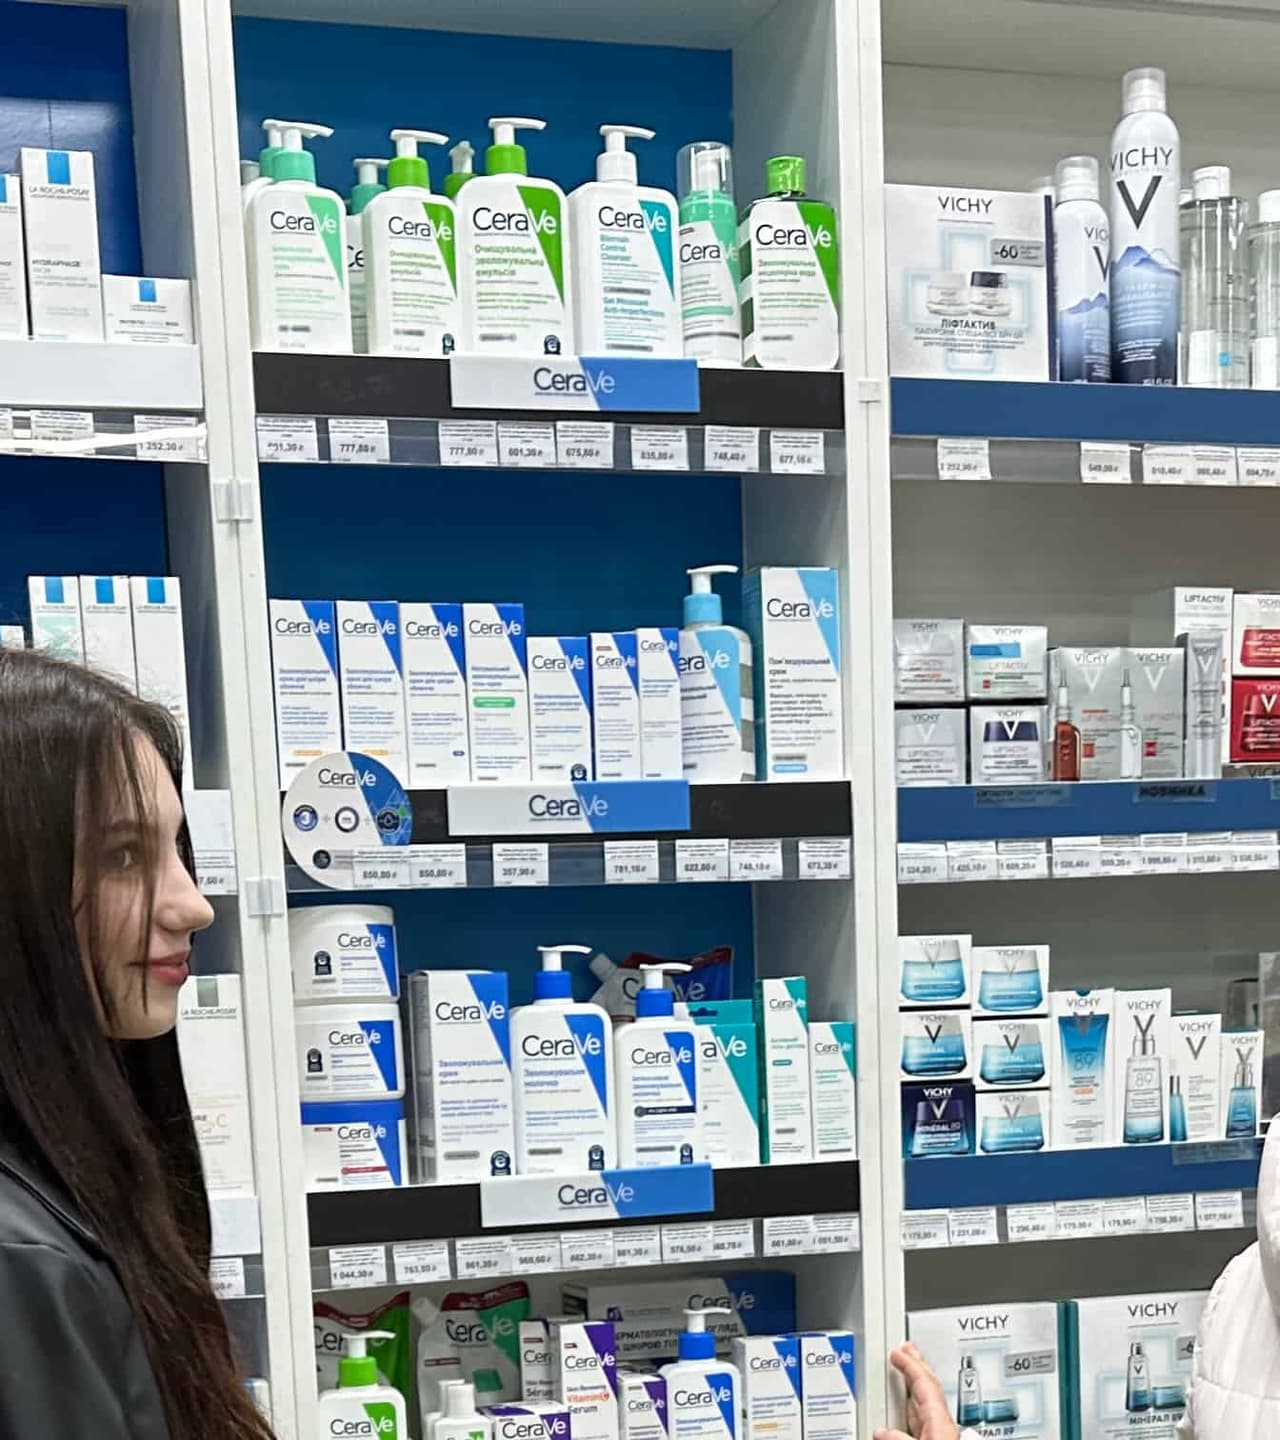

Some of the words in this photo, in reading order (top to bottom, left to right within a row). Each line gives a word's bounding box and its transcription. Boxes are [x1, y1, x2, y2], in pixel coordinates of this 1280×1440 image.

[1110, 147, 1174, 170] VICHY
[938, 197, 992, 213] VICHY
[270, 209, 337, 235] CeraVe
[472, 206, 558, 235] CeraVe
[598, 206, 666, 232] CeraVe
[388, 216, 452, 241] CeraVe
[756, 224, 832, 248] CeraVe
[994, 246, 1018, 260] -60
[534, 366, 615, 396] CeraVe
[767, 598, 834, 619] CeraVe
[275, 618, 330, 634] CeraVe
[342, 618, 396, 634] CeraVe
[406, 621, 459, 637] CeraVe
[469, 620, 521, 636] CeraVe
[640, 640, 677, 651] CeraVe
[532, 655, 584, 670] CeraVe
[596, 655, 635, 667] CeraVe
[1075, 653, 1109, 664] VICHY
[1137, 653, 1170, 663] VICHY
[319, 769, 376, 788] CeraVe
[529, 794, 608, 821] CeraVe
[337, 932, 386, 950] CeraVe
[436, 1001, 505, 1020] CeraVe
[1067, 999, 1100, 1007] VICHY
[1127, 1000, 1162, 1010] VICHY
[1180, 1022, 1213, 1032] VICHY
[329, 1028, 381, 1047] CeraVe
[523, 1034, 600, 1056] CeraVe
[1231, 1037, 1258, 1046] VICHY
[632, 1046, 693, 1064] CeraVe
[923, 1088, 952, 1097] VICHY
[337, 1124, 386, 1140] CeraVe
[558, 1183, 634, 1208] CeraVe
[1128, 1303, 1178, 1317] VICHY
[958, 1315, 1008, 1330] VICHY
[565, 1352, 615, 1369] CeraVe
[750, 1355, 796, 1370] CeraVe
[806, 1352, 851, 1365] CeraVe
[1008, 1358, 1031, 1371] -60
[628, 1399, 663, 1410] CeraVe
[674, 1388, 731, 1406] CeraVe
[330, 1416, 394, 1435] CeraVe
[503, 1418, 566, 1439] CeraVe
